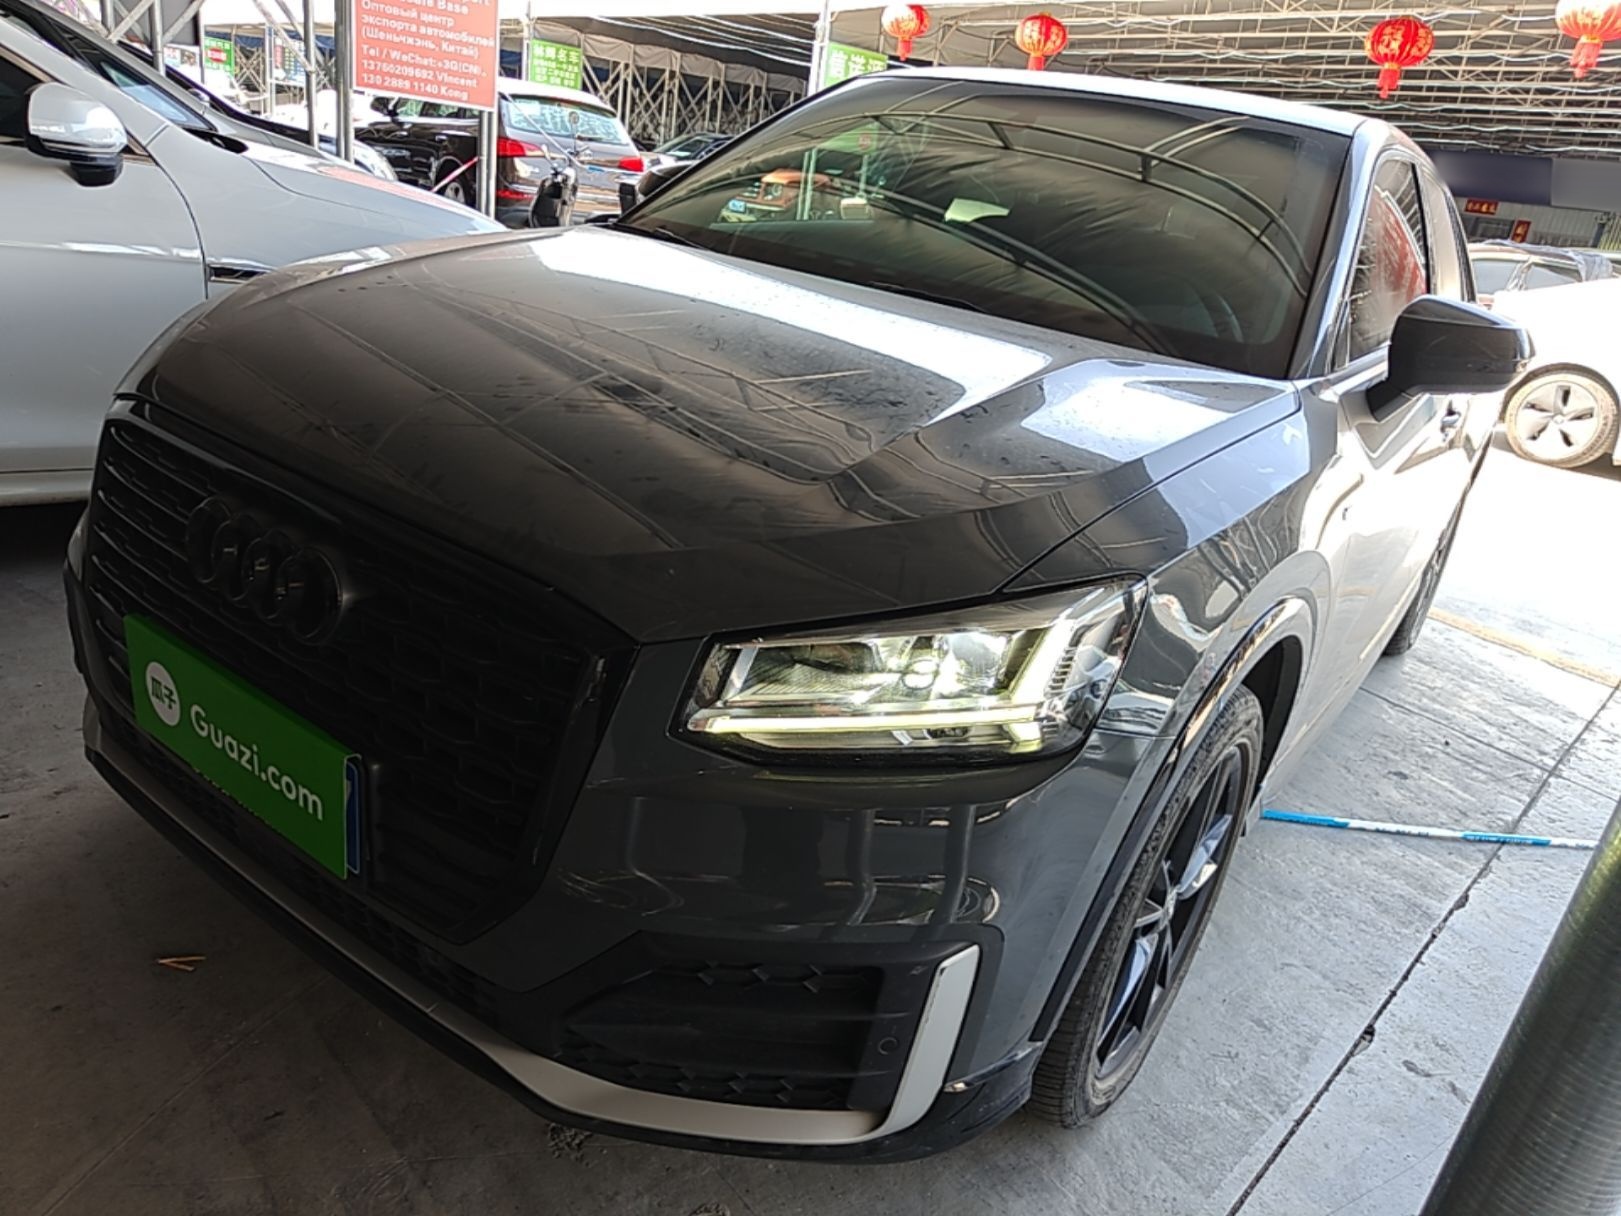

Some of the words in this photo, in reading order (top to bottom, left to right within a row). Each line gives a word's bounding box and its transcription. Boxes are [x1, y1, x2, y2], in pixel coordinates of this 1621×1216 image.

[362, 1, 418, 18] Оптовый
[420, 12, 454, 27] центр
[361, 15, 417, 32] экспорта
[419, 26, 495, 47] автомобилей
[362, 45, 379, 57] Tel
[362, 73, 382, 84] 130
[413, 82, 438, 94] 1140
[440, 86, 468, 101] Kong
[151, 676, 177, 710] 瓜子
[190, 704, 323, 821] Guazi.com
